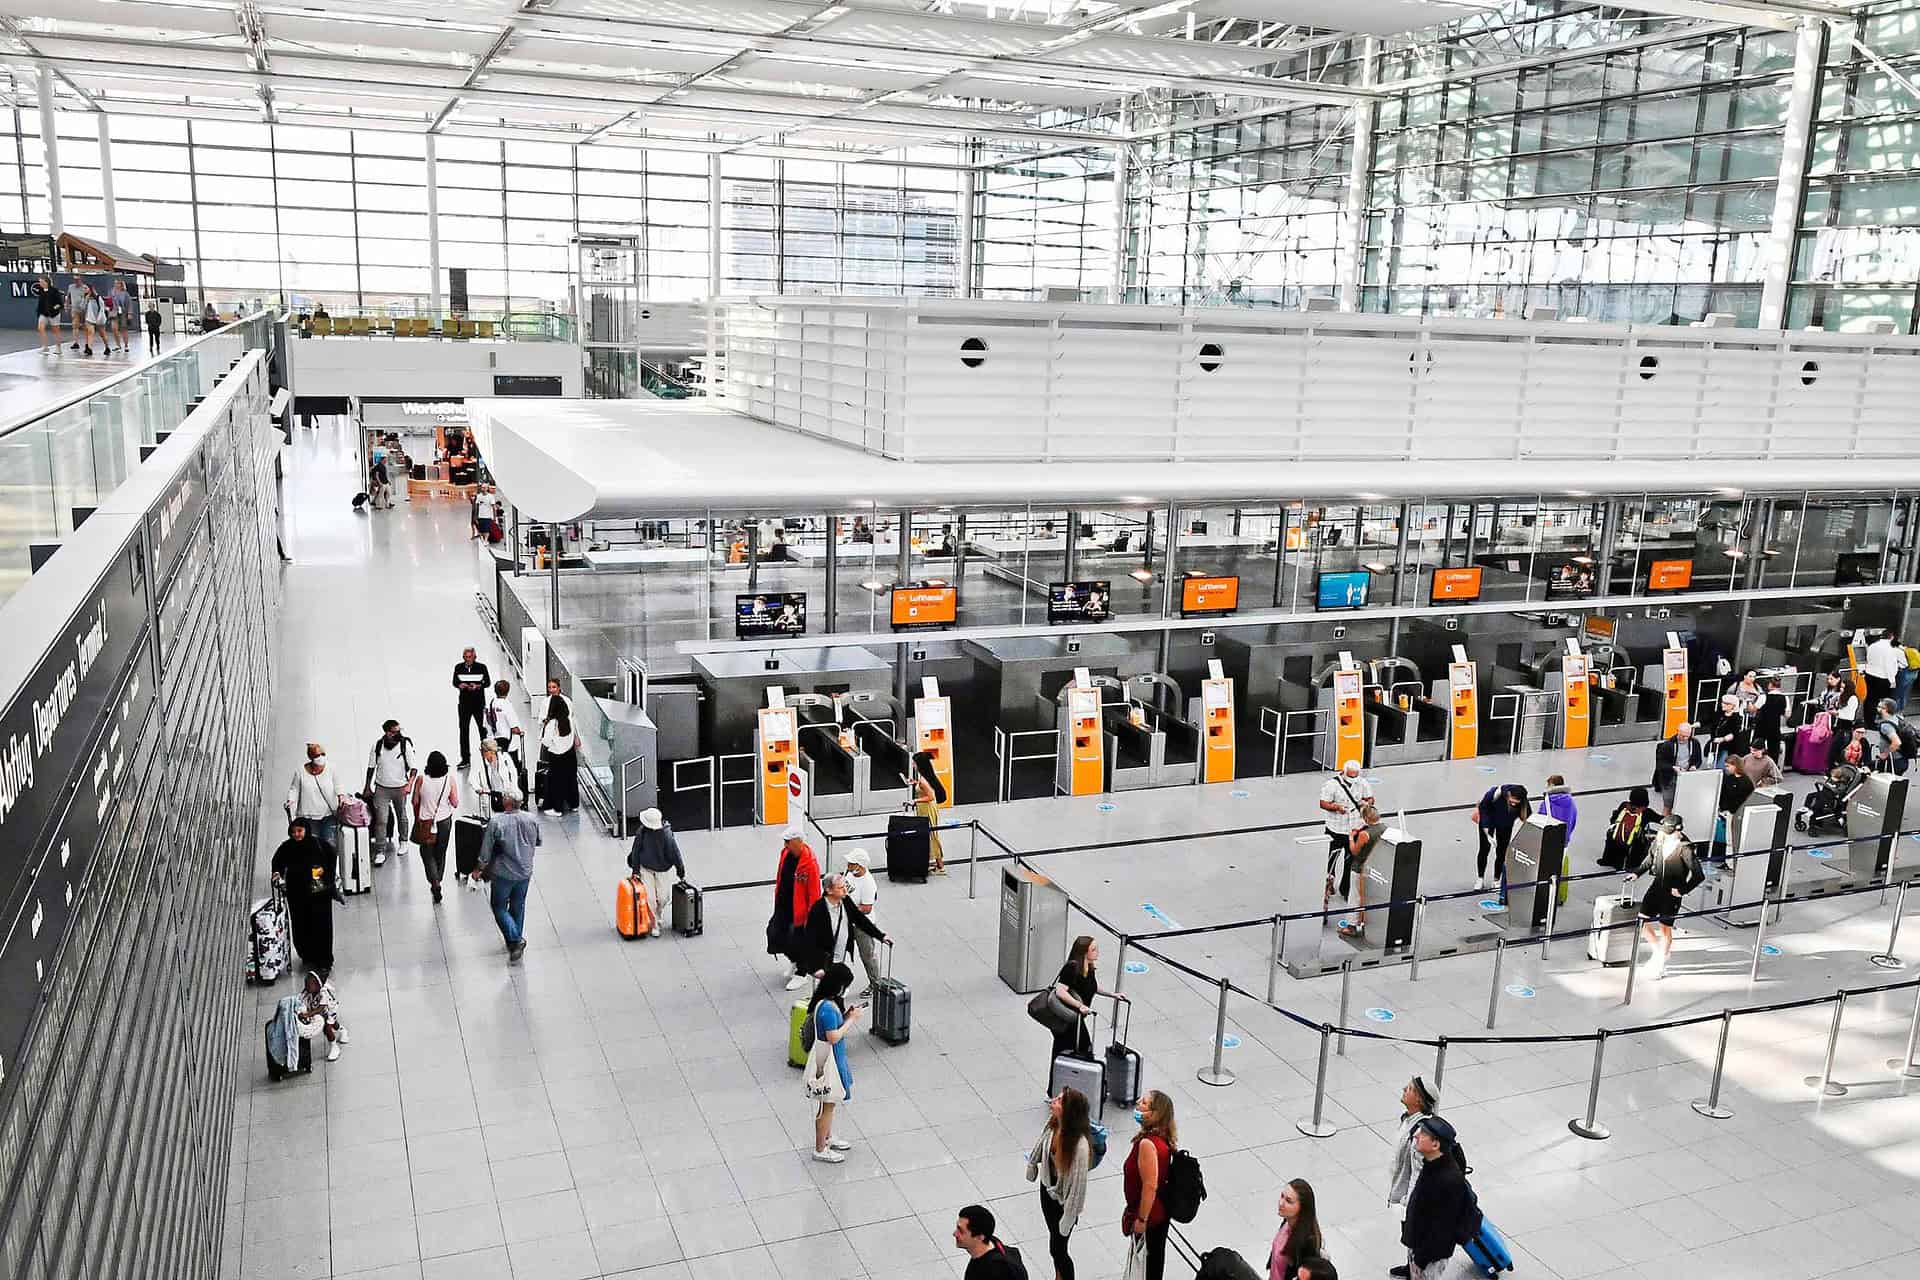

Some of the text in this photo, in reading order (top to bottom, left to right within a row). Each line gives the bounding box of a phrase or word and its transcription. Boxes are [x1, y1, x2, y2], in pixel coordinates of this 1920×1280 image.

[0, 732, 34, 824] Abflug
[32, 659, 78, 758] Departures
[76, 603, 104, 682] Terminal
